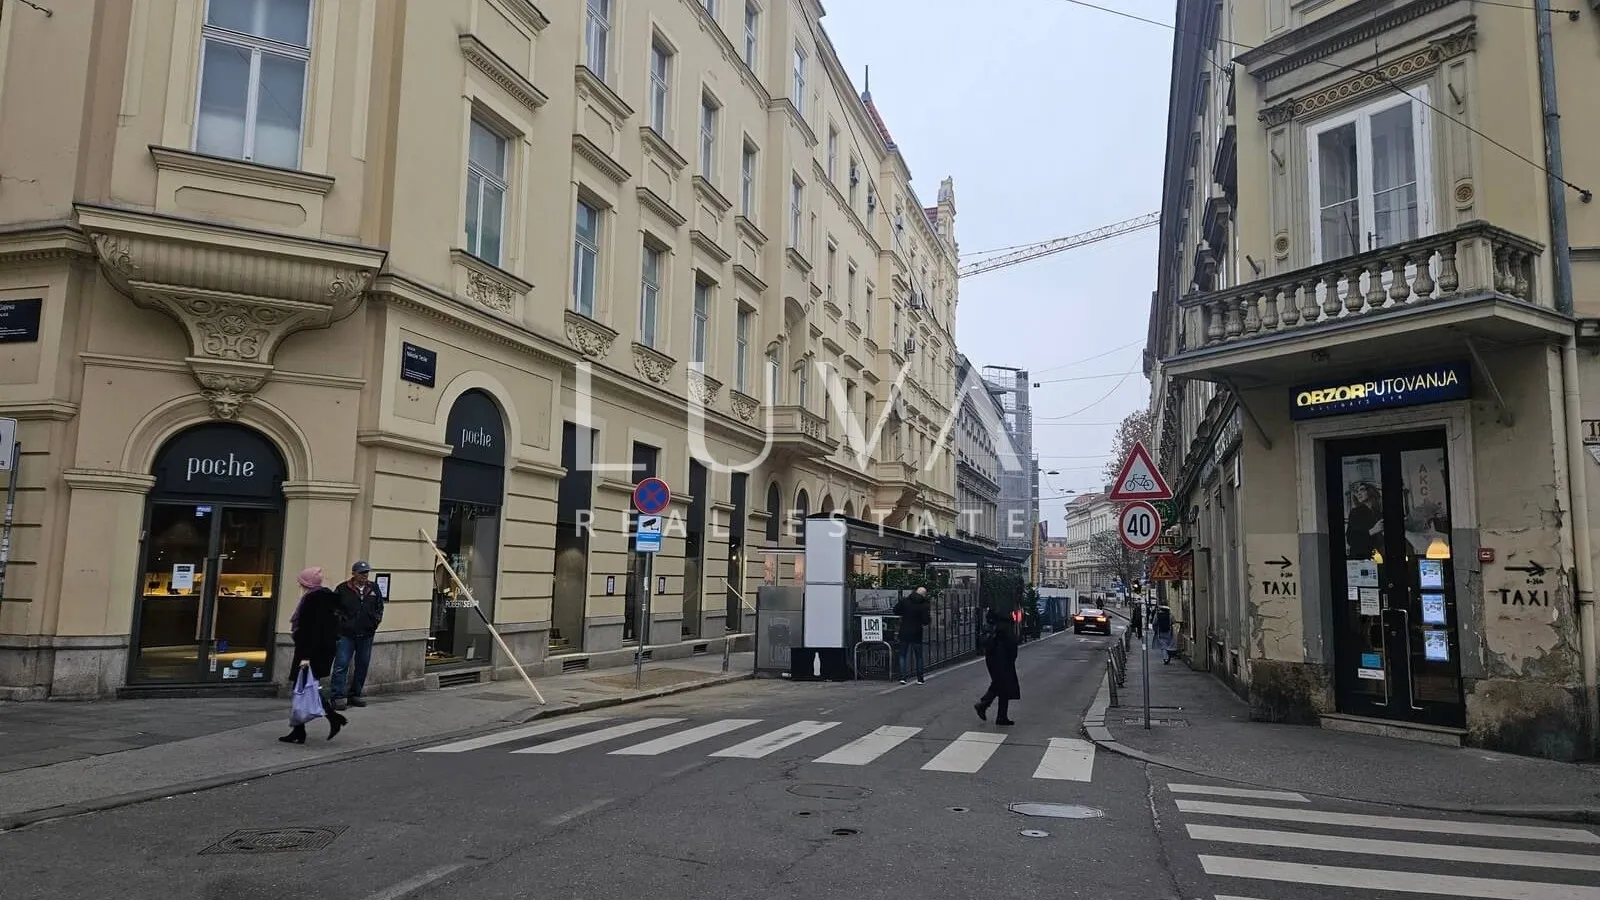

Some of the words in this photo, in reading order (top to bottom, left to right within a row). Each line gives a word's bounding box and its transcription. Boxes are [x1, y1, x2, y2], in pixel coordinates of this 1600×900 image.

[461, 426, 492, 448] poche
[186, 452, 255, 481] poche
[1127, 513, 1151, 537] 40
[1262, 581, 1297, 596] TAXI
[1498, 588, 1549, 607] TAXI
